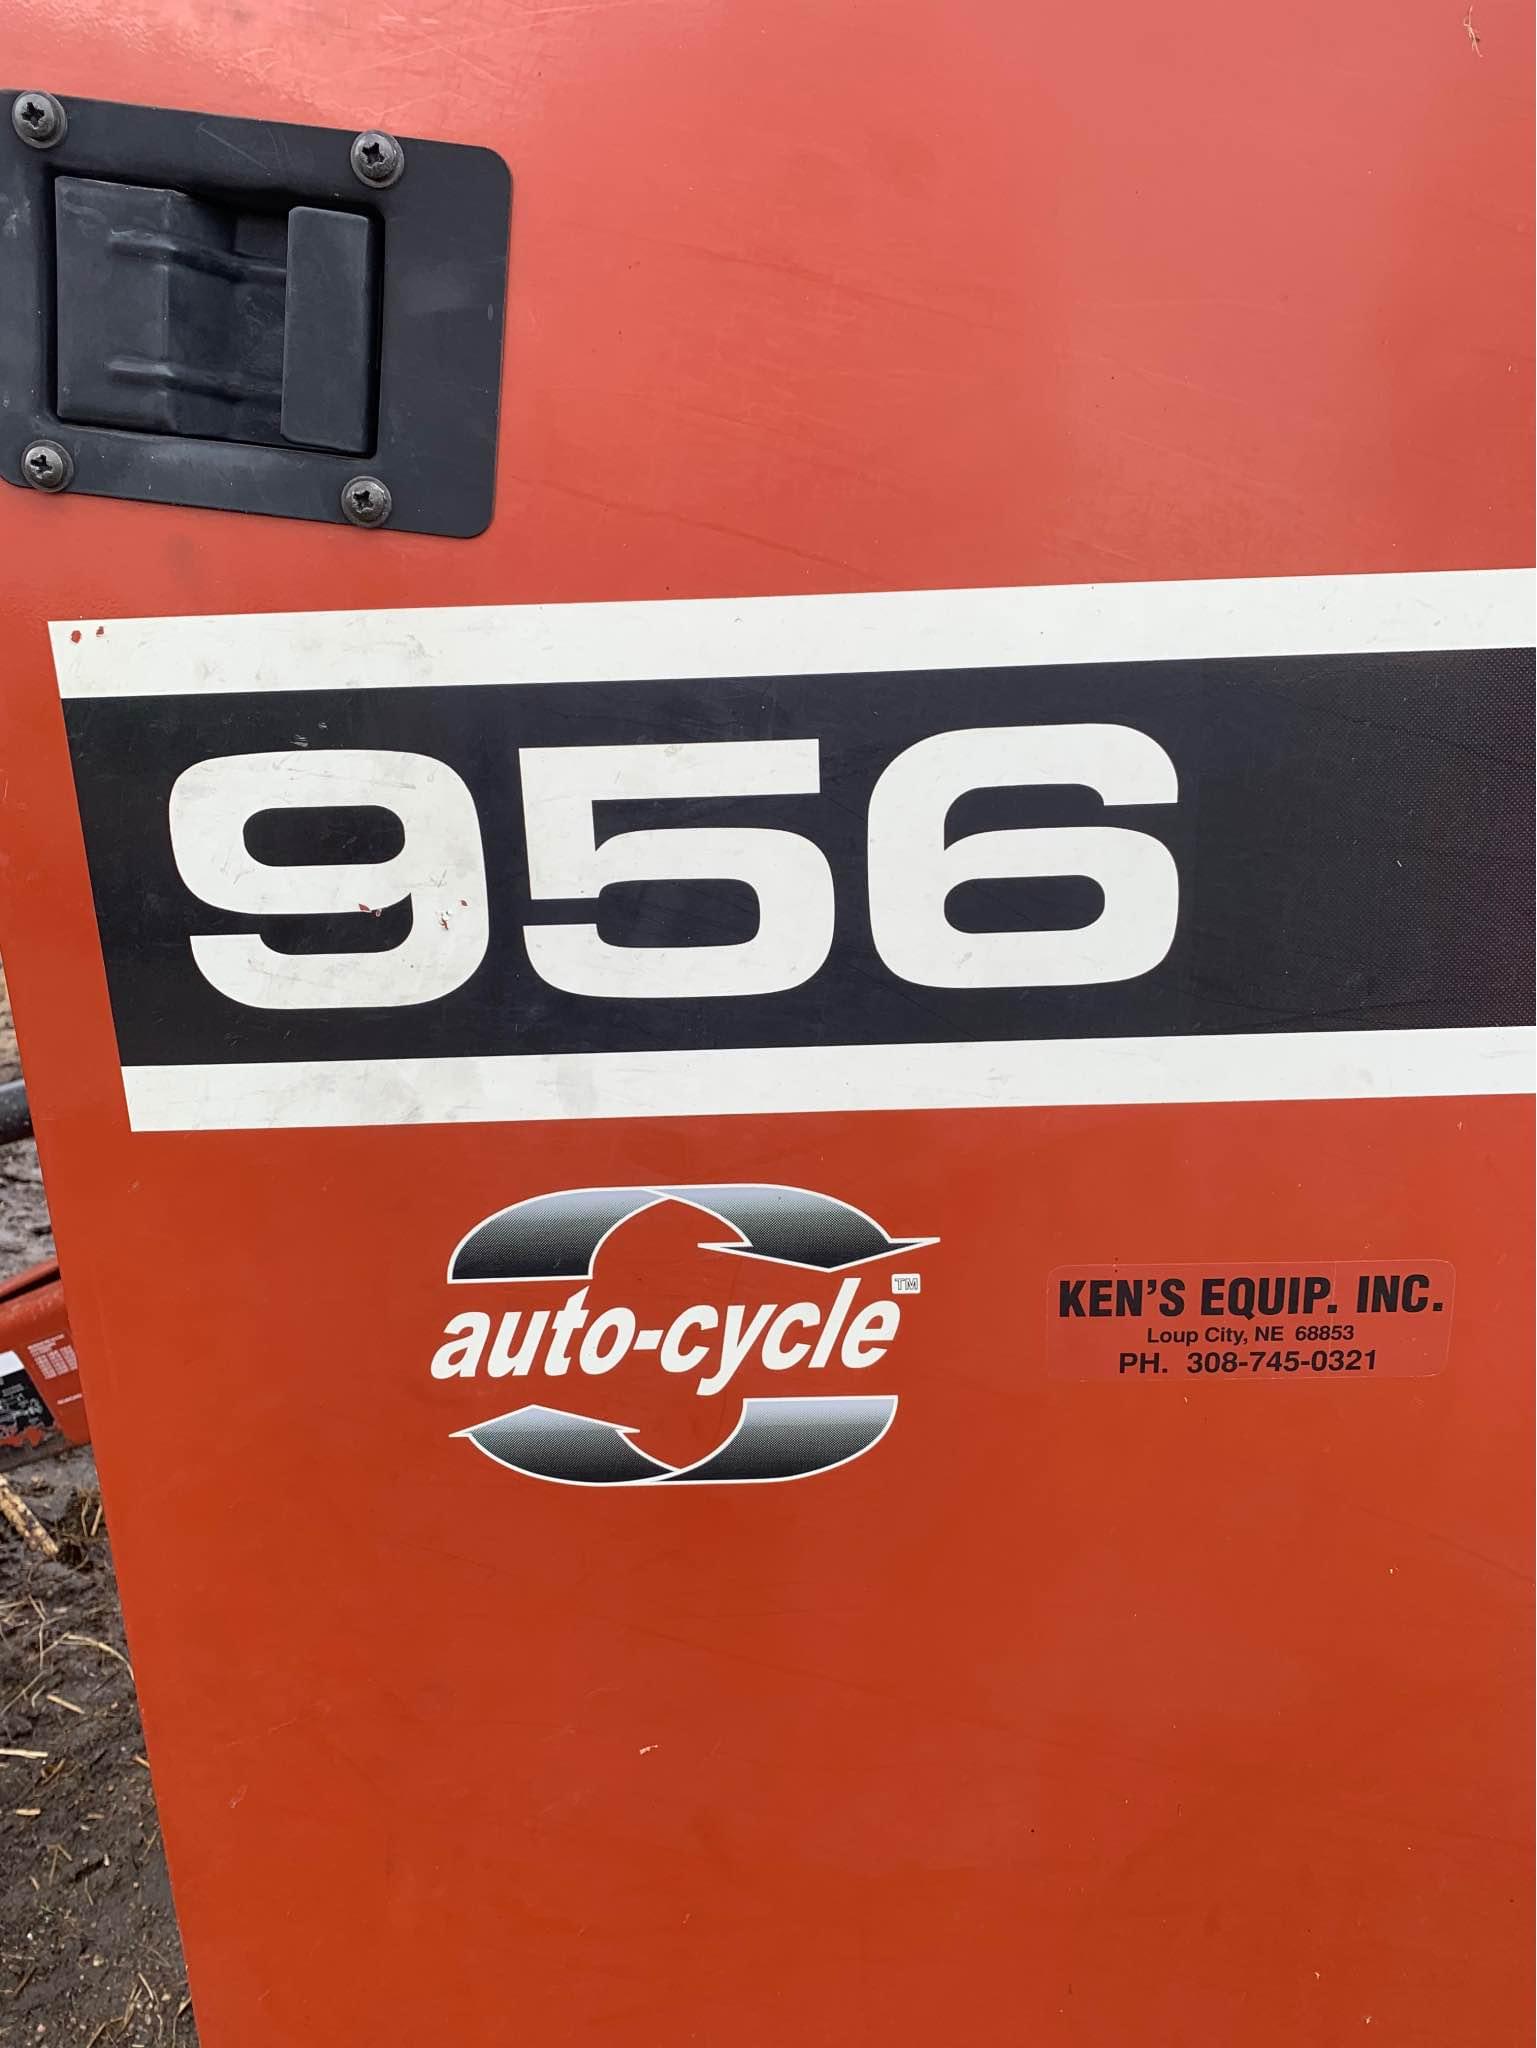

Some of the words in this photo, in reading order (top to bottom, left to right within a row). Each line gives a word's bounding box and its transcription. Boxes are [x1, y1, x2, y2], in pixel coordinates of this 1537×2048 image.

[169, 723, 1180, 1011] 956
[894, 1277, 919, 1292] TM
[1058, 1277, 1186, 1317] KEN'S
[1200, 1276, 1338, 1320] EQUIP.
[1356, 1274, 1443, 1313] INC.
[430, 1277, 901, 1397] auto-cycle
[1146, 1327, 1199, 1347] Loup
[1204, 1326, 1249, 1346] City,
[1254, 1326, 1284, 1342] NE
[1294, 1325, 1354, 1342] 68853
[1119, 1352, 1168, 1374] PH.
[1186, 1349, 1378, 1374] 308-745-0321
